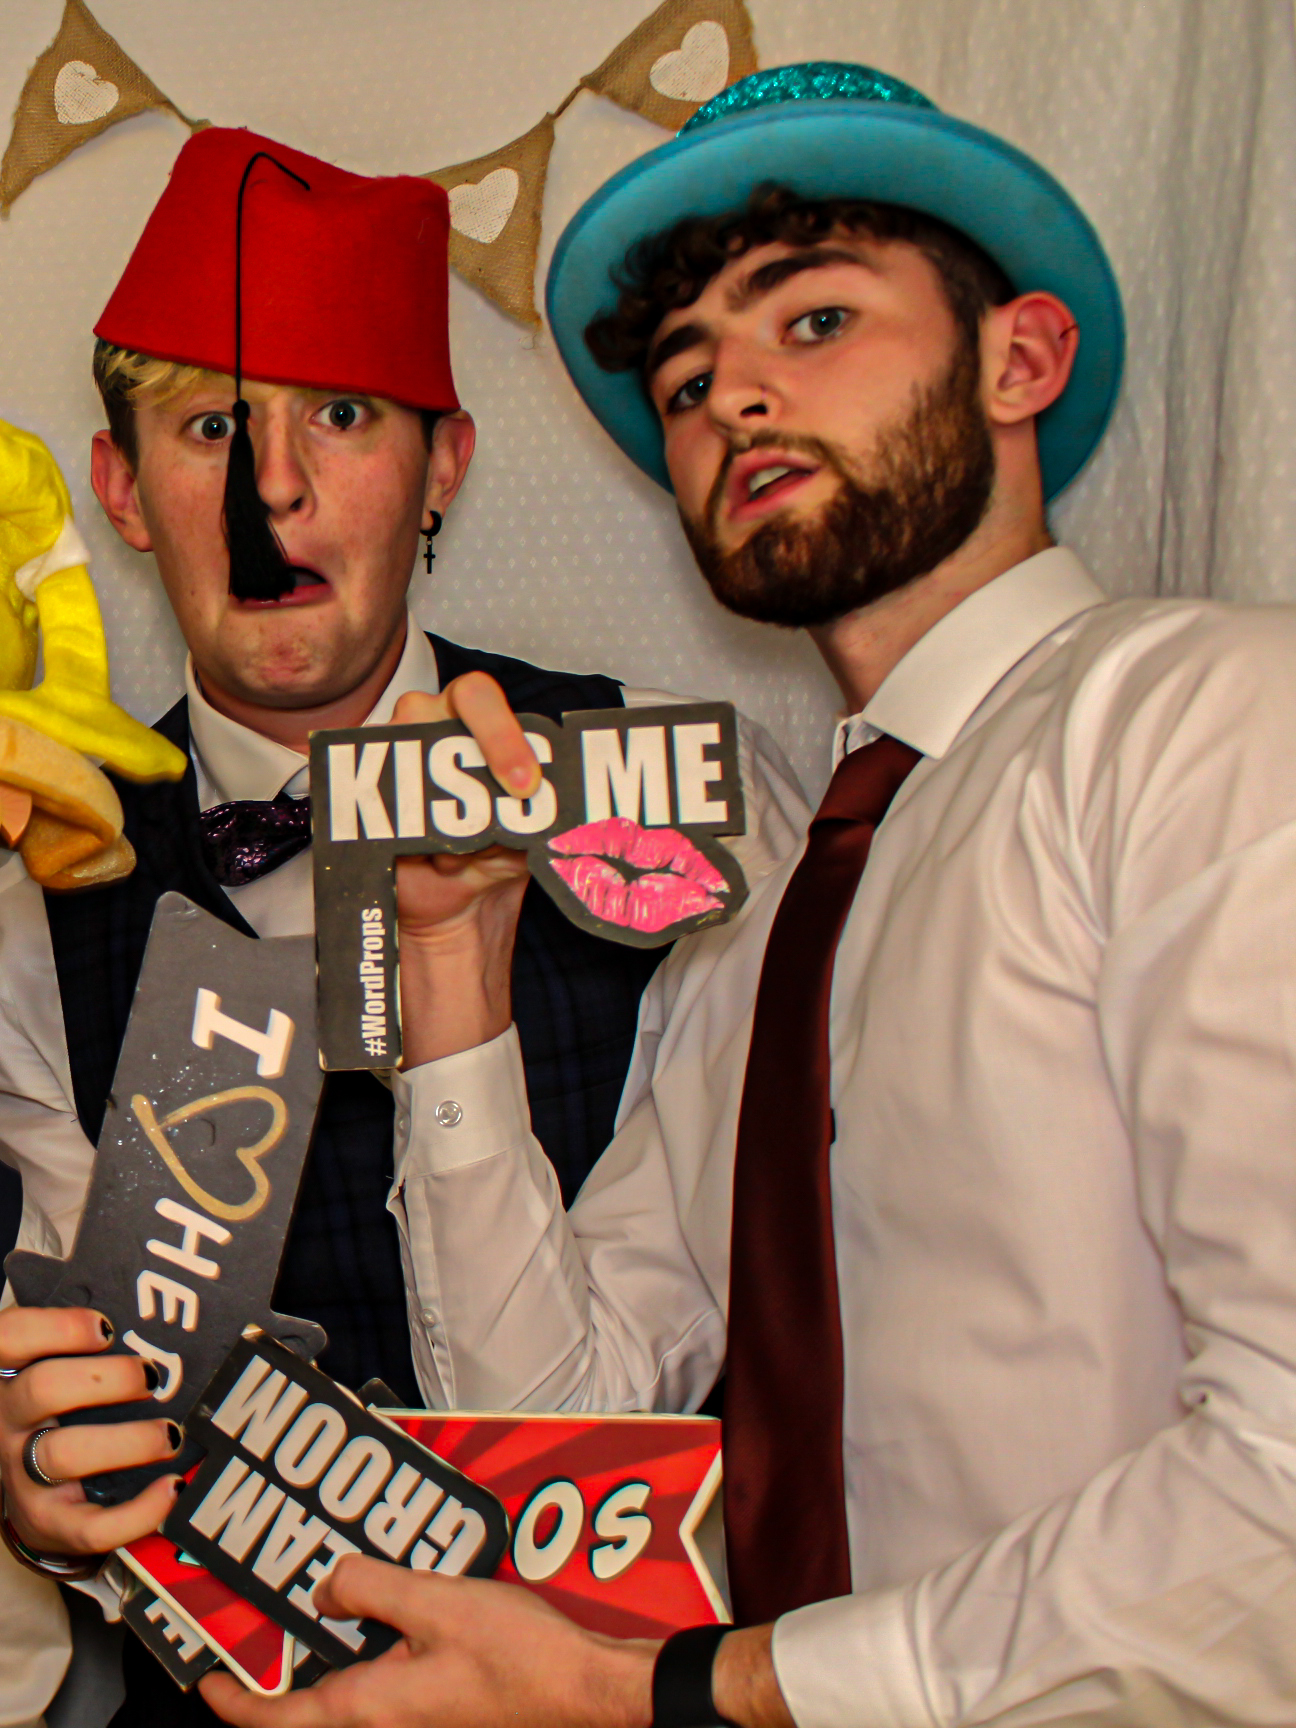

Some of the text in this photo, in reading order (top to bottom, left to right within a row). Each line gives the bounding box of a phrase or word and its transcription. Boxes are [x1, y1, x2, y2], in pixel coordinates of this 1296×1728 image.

[328, 722, 729, 842] KISS ME
[191, 987, 294, 1079] I
[360, 908, 387, 1057] #WordProps
[211, 1355, 487, 1576] GROOM
